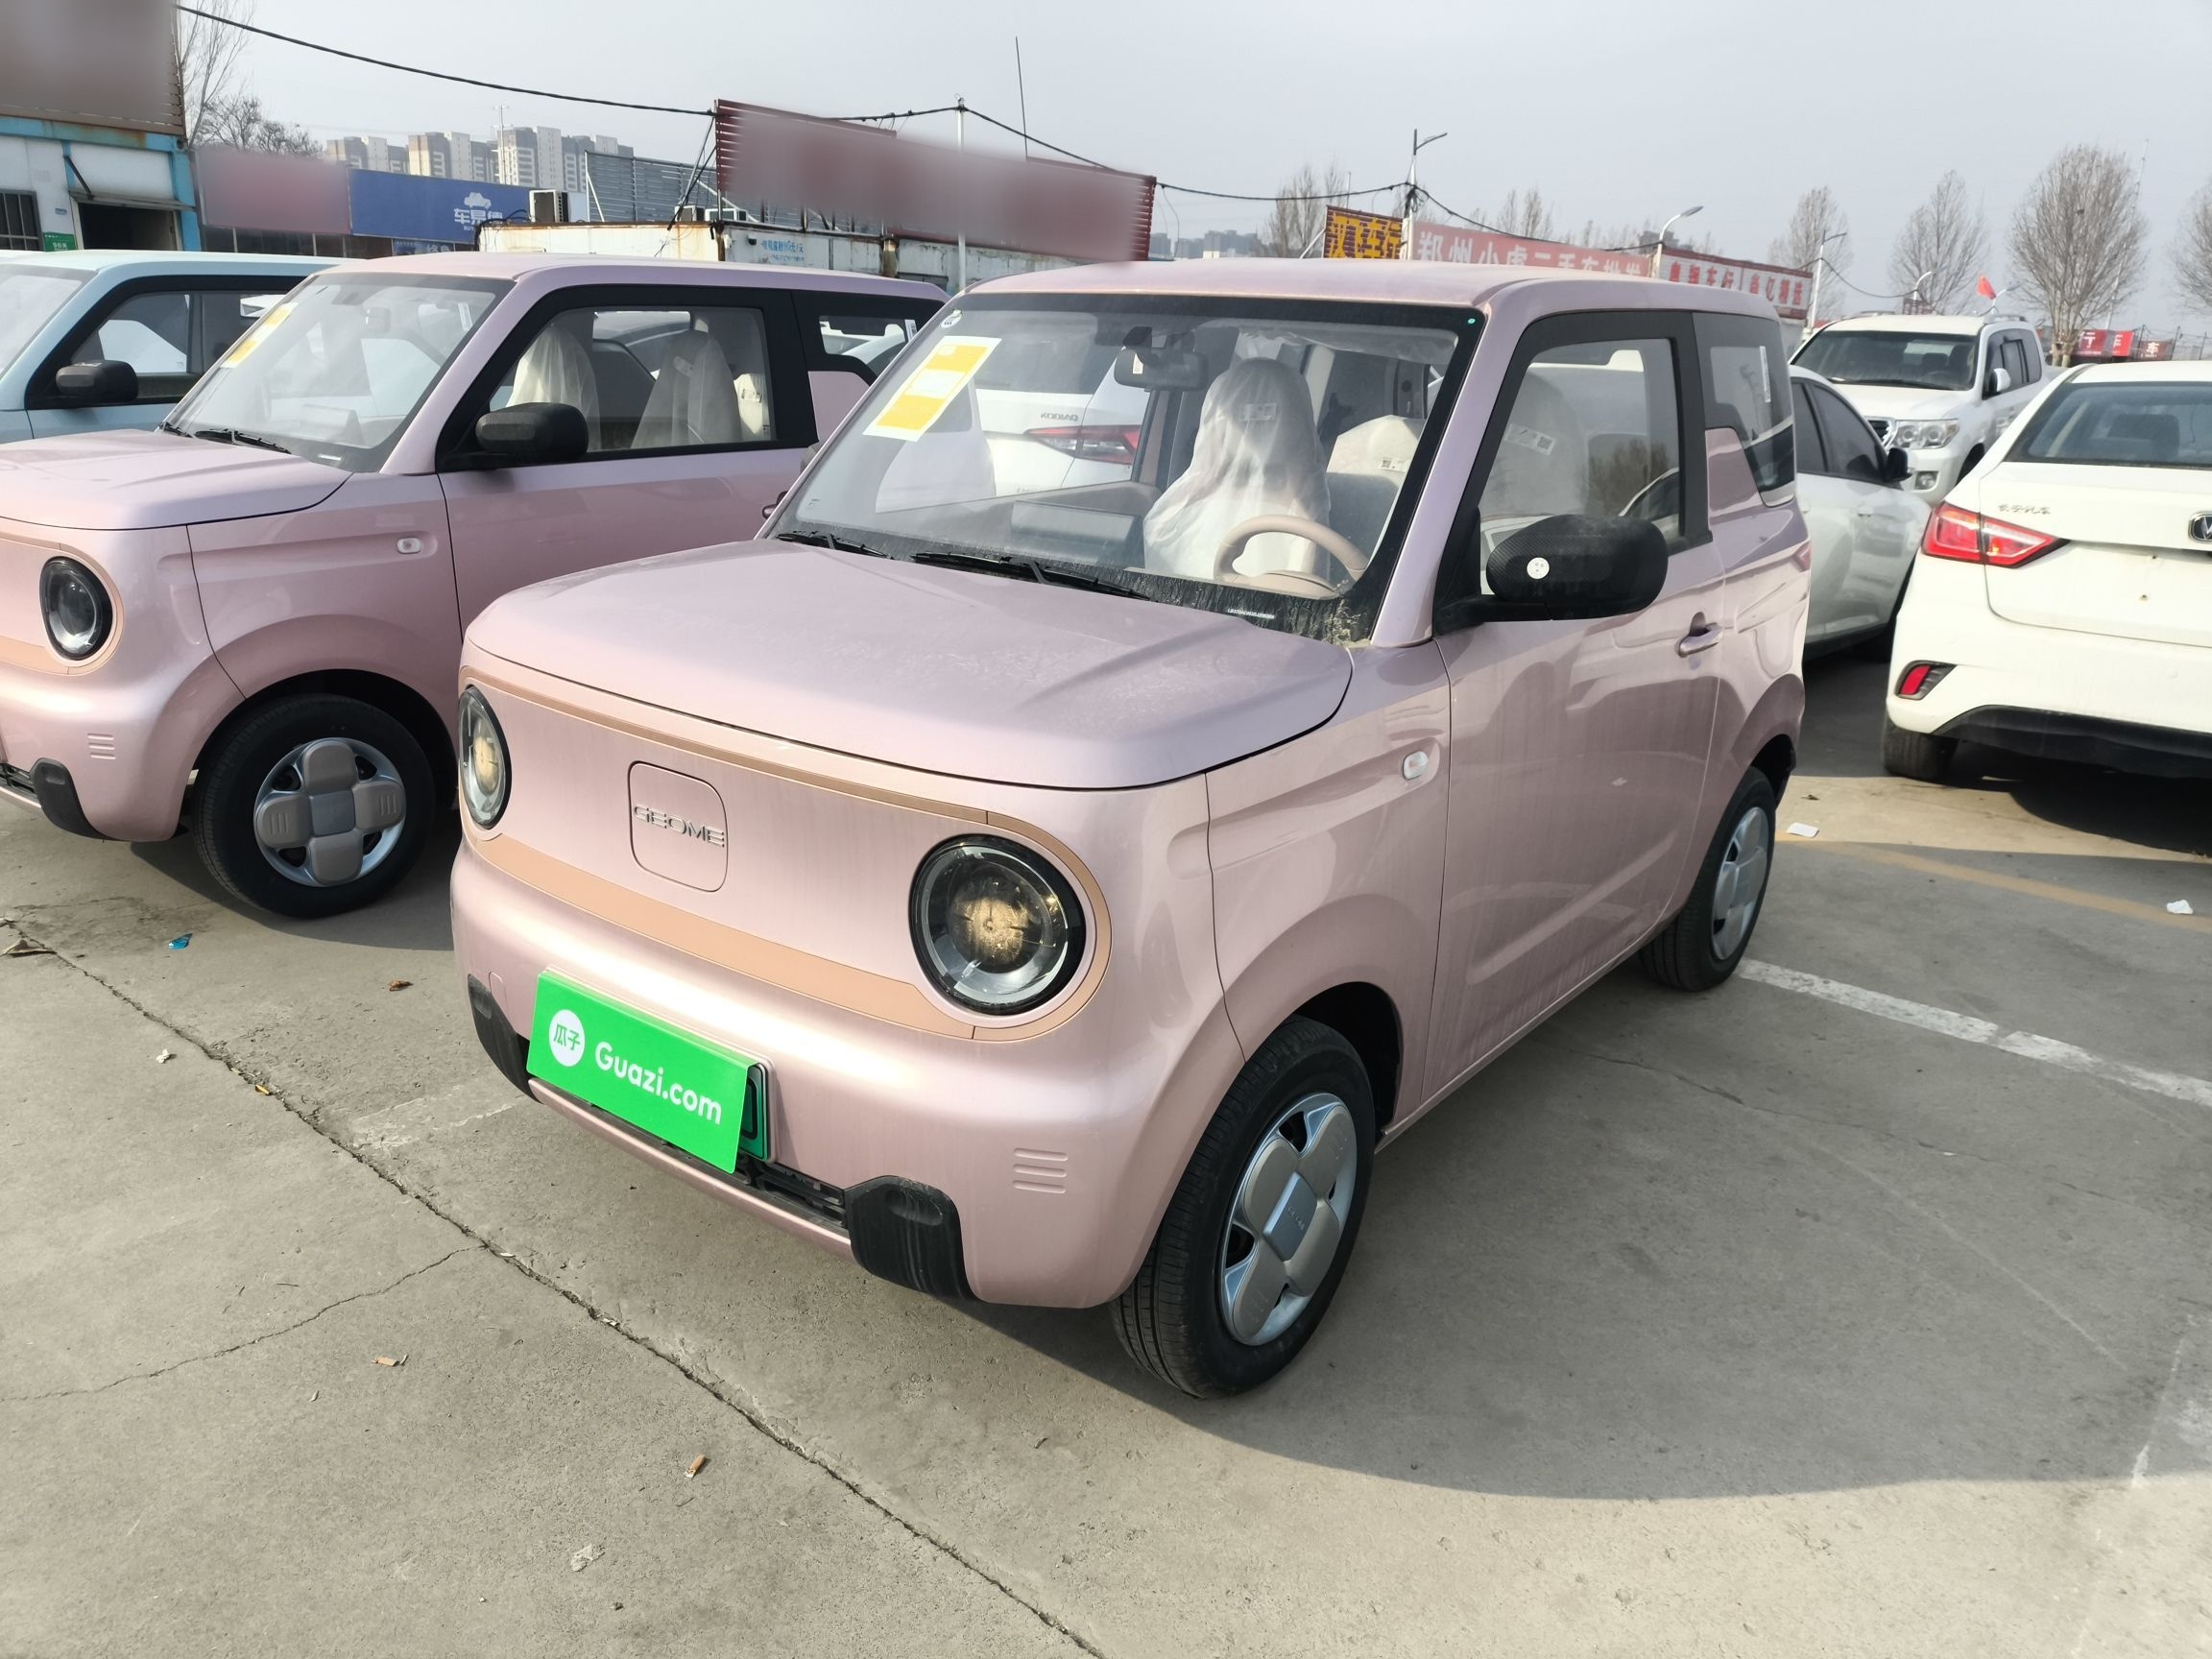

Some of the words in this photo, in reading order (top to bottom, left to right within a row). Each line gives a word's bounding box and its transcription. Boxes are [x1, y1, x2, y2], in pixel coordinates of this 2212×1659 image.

[634, 805, 725, 848] GEOME
[553, 1023, 581, 1051] 瓜子
[594, 1041, 723, 1125] Guazi.com
